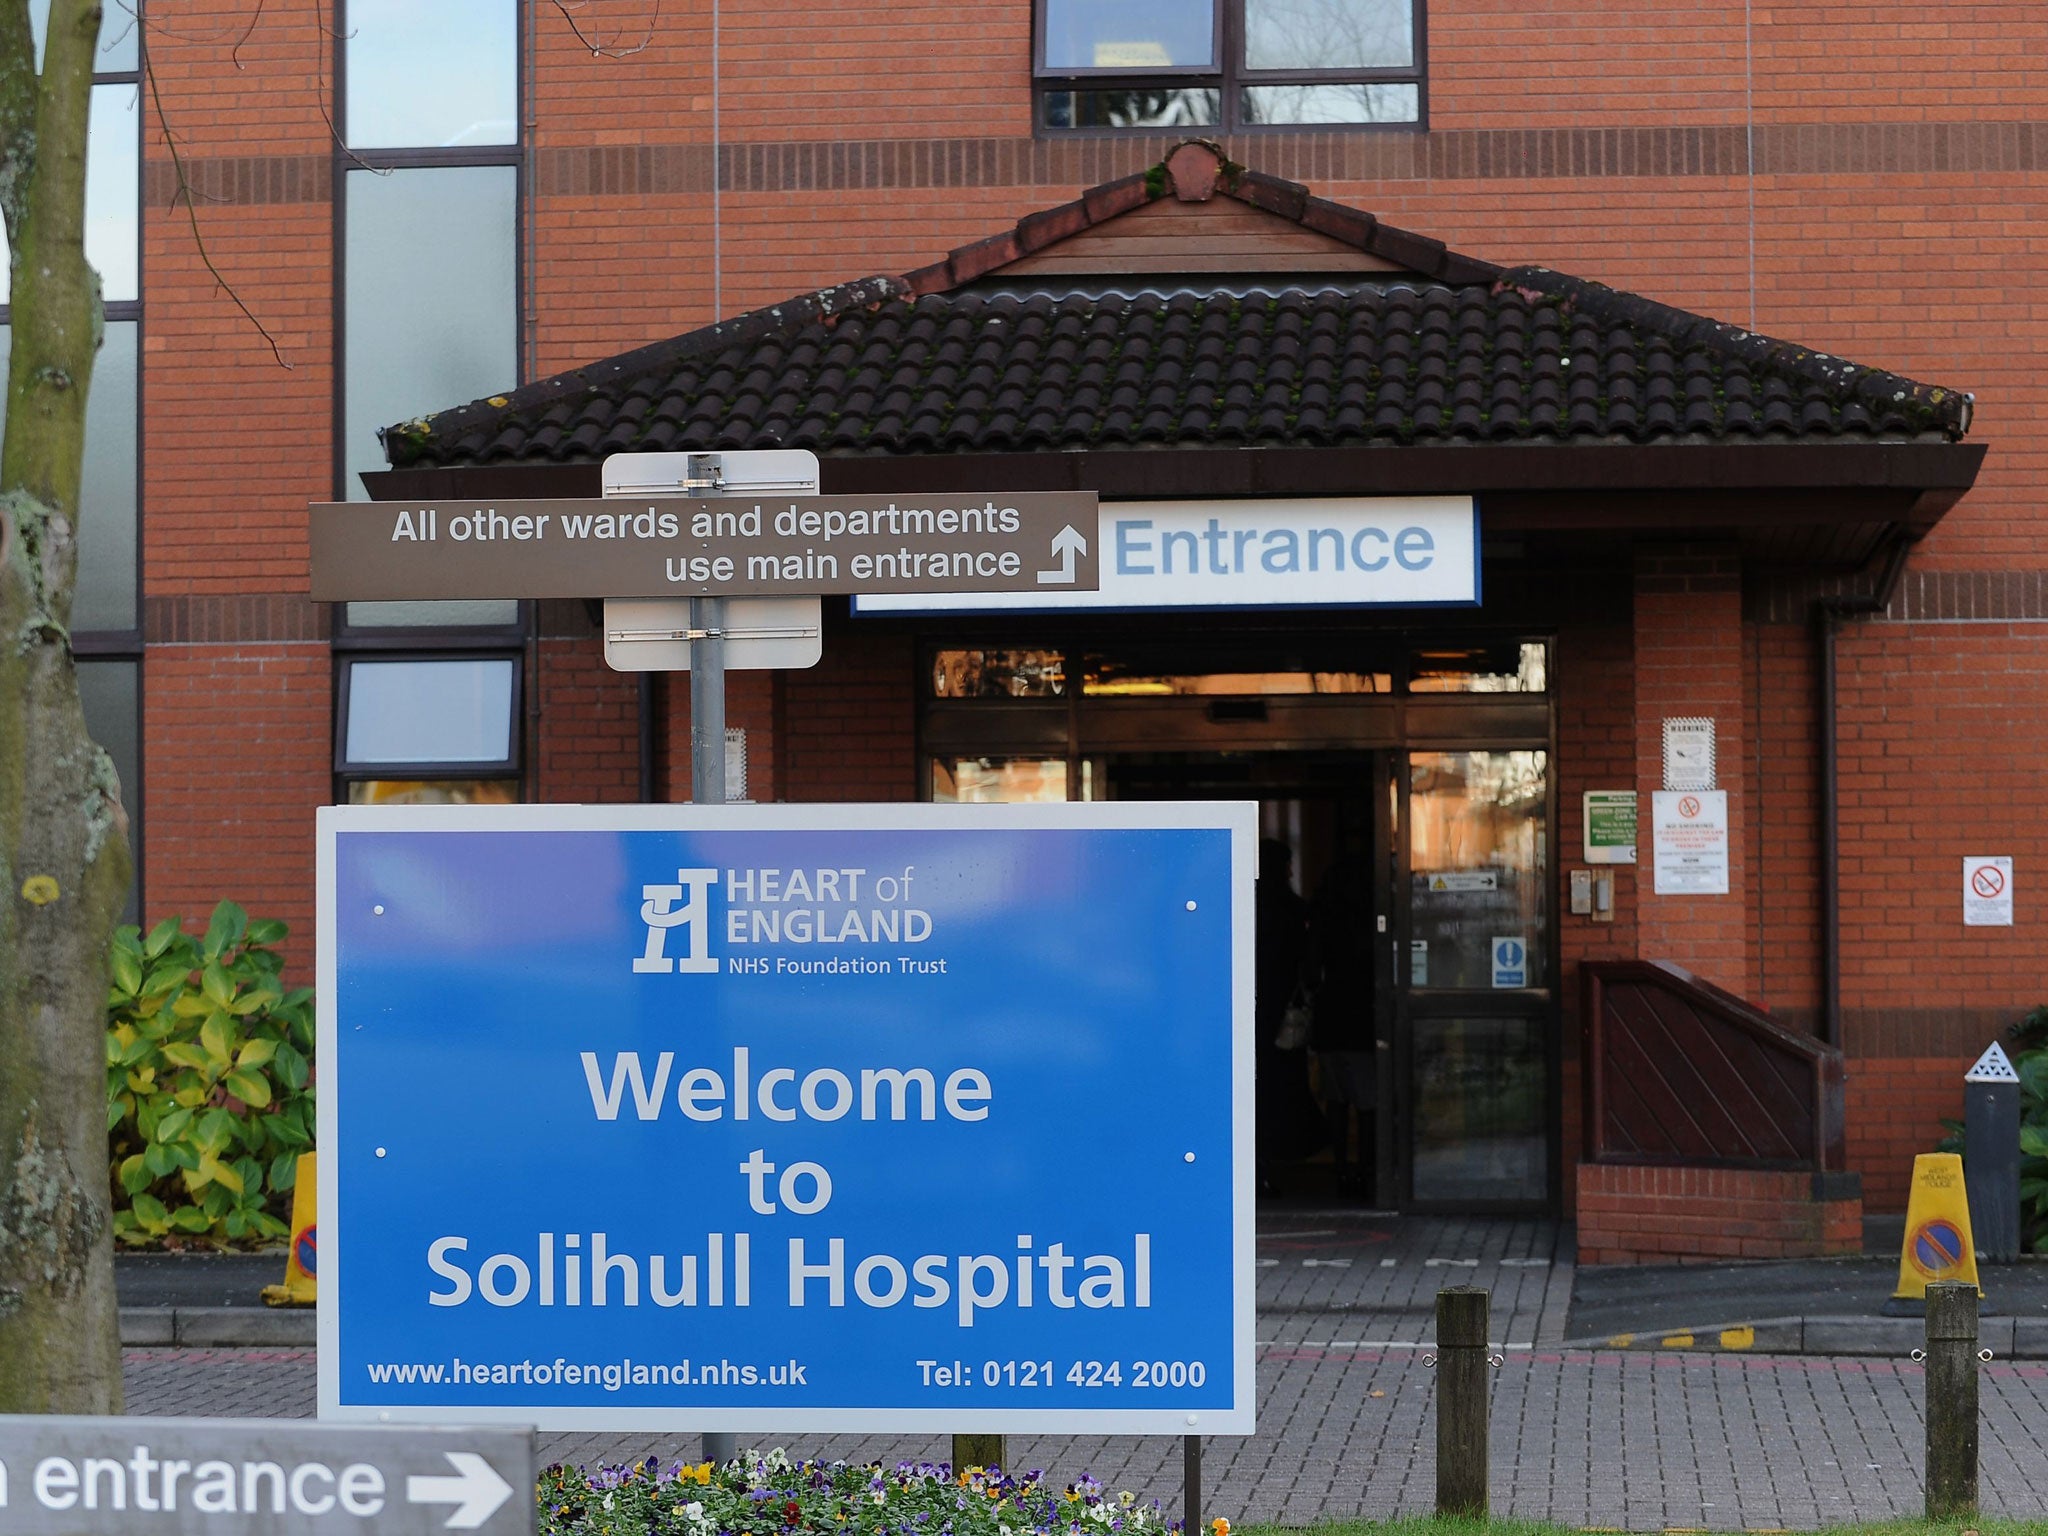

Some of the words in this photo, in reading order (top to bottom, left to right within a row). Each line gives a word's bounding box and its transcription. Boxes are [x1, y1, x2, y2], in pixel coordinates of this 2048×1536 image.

[391, 508, 437, 542] All
[448, 507, 550, 542] other
[561, 506, 679, 540] wards
[691, 505, 762, 538] and
[774, 502, 1020, 542] departments
[665, 555, 734, 583] use
[747, 548, 838, 581] main
[850, 547, 1021, 580] entrance
[1115, 518, 1435, 576] Entrance
[727, 868, 866, 902] HEART
[875, 865, 914, 902] of
[727, 909, 933, 943] ENGLAND
[729, 957, 770, 974] NHS
[776, 956, 891, 974] Foundation
[897, 957, 947, 974] Trust
[579, 1046, 992, 1122] Welcome
[739, 1148, 833, 1215] to
[427, 1232, 750, 1308] Solihull
[788, 1233, 1151, 1328] Hospital
[367, 1358, 808, 1391] www.heartofengland.nhs.uk
[916, 1360, 971, 1387] Tel:
[983, 1360, 1053, 1387] 0121
[1066, 1360, 1123, 1387] 424
[1131, 1361, 1206, 1388] 2000
[33, 1445, 386, 1517] entrance
